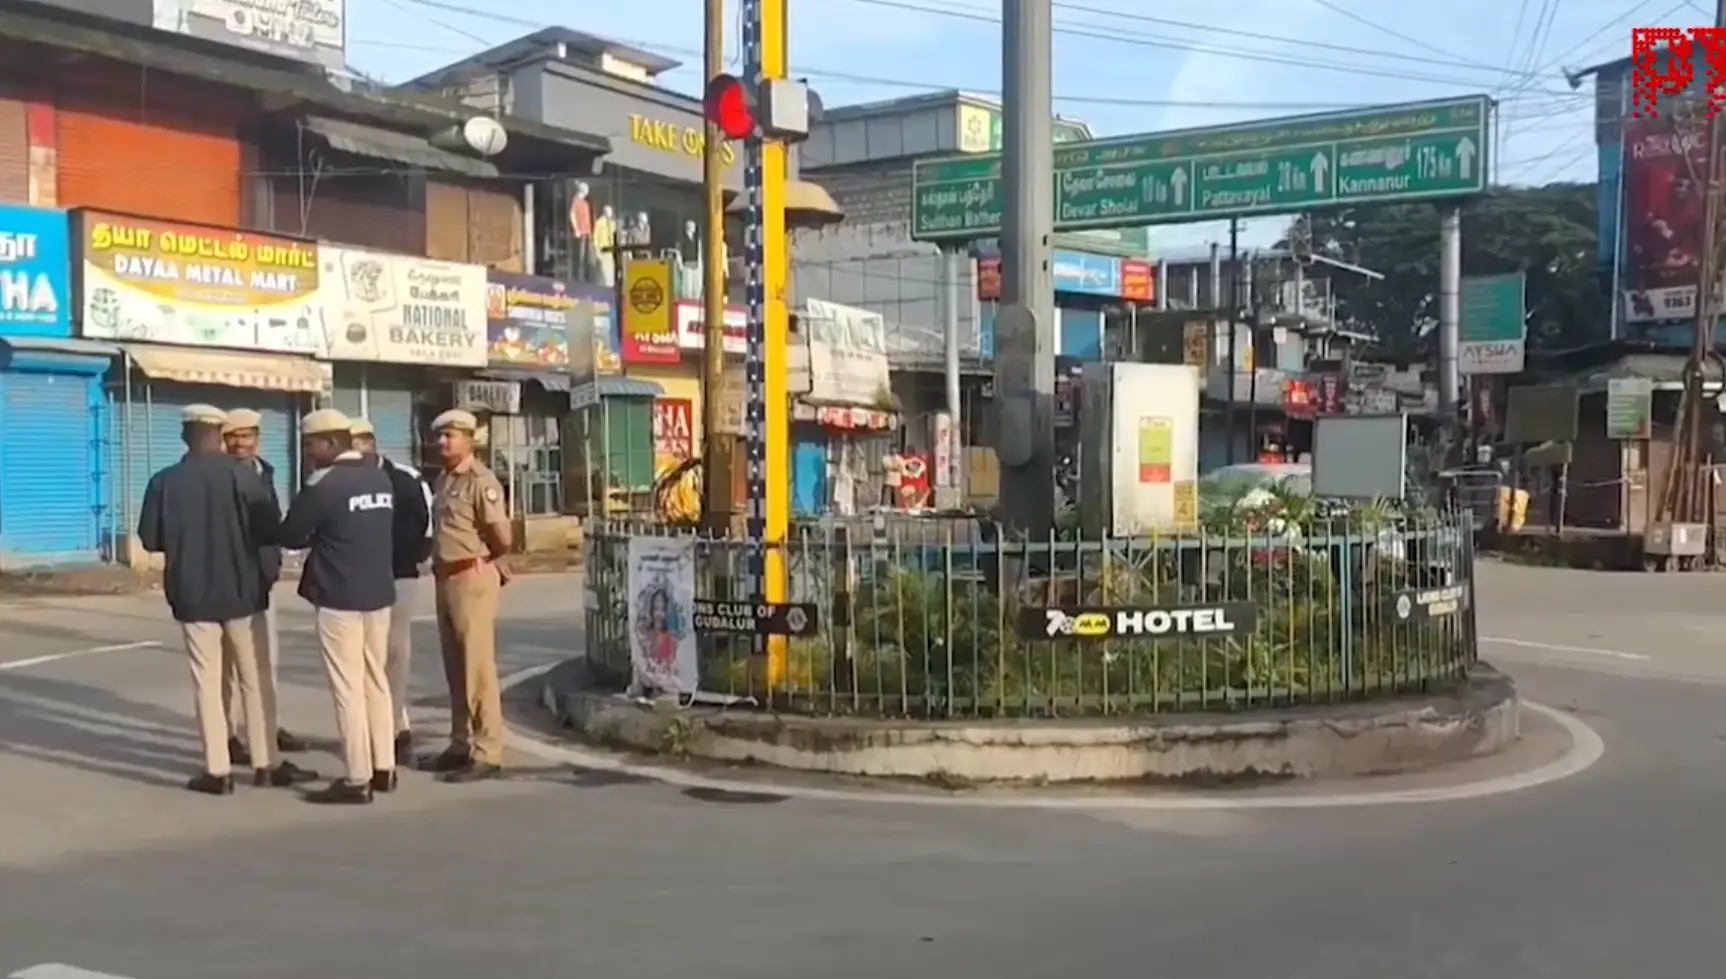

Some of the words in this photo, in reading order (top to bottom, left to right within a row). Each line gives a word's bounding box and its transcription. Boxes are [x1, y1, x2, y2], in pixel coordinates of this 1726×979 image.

[628, 113, 678, 152] TAKE
[1417, 146, 1437, 179] 175
[1339, 175, 1412, 194] Kannanur
[115, 255, 178, 281] DAYAA
[185, 263, 243, 286] METAL
[250, 271, 297, 292] MART
[403, 304, 468, 329] NATIONAL
[389, 327, 477, 348] BAKERY
[349, 493, 393, 512] POLIC
[719, 605, 752, 617] CLUB
[756, 607, 776, 618] OF
[1116, 608, 1235, 635] HOTEL
